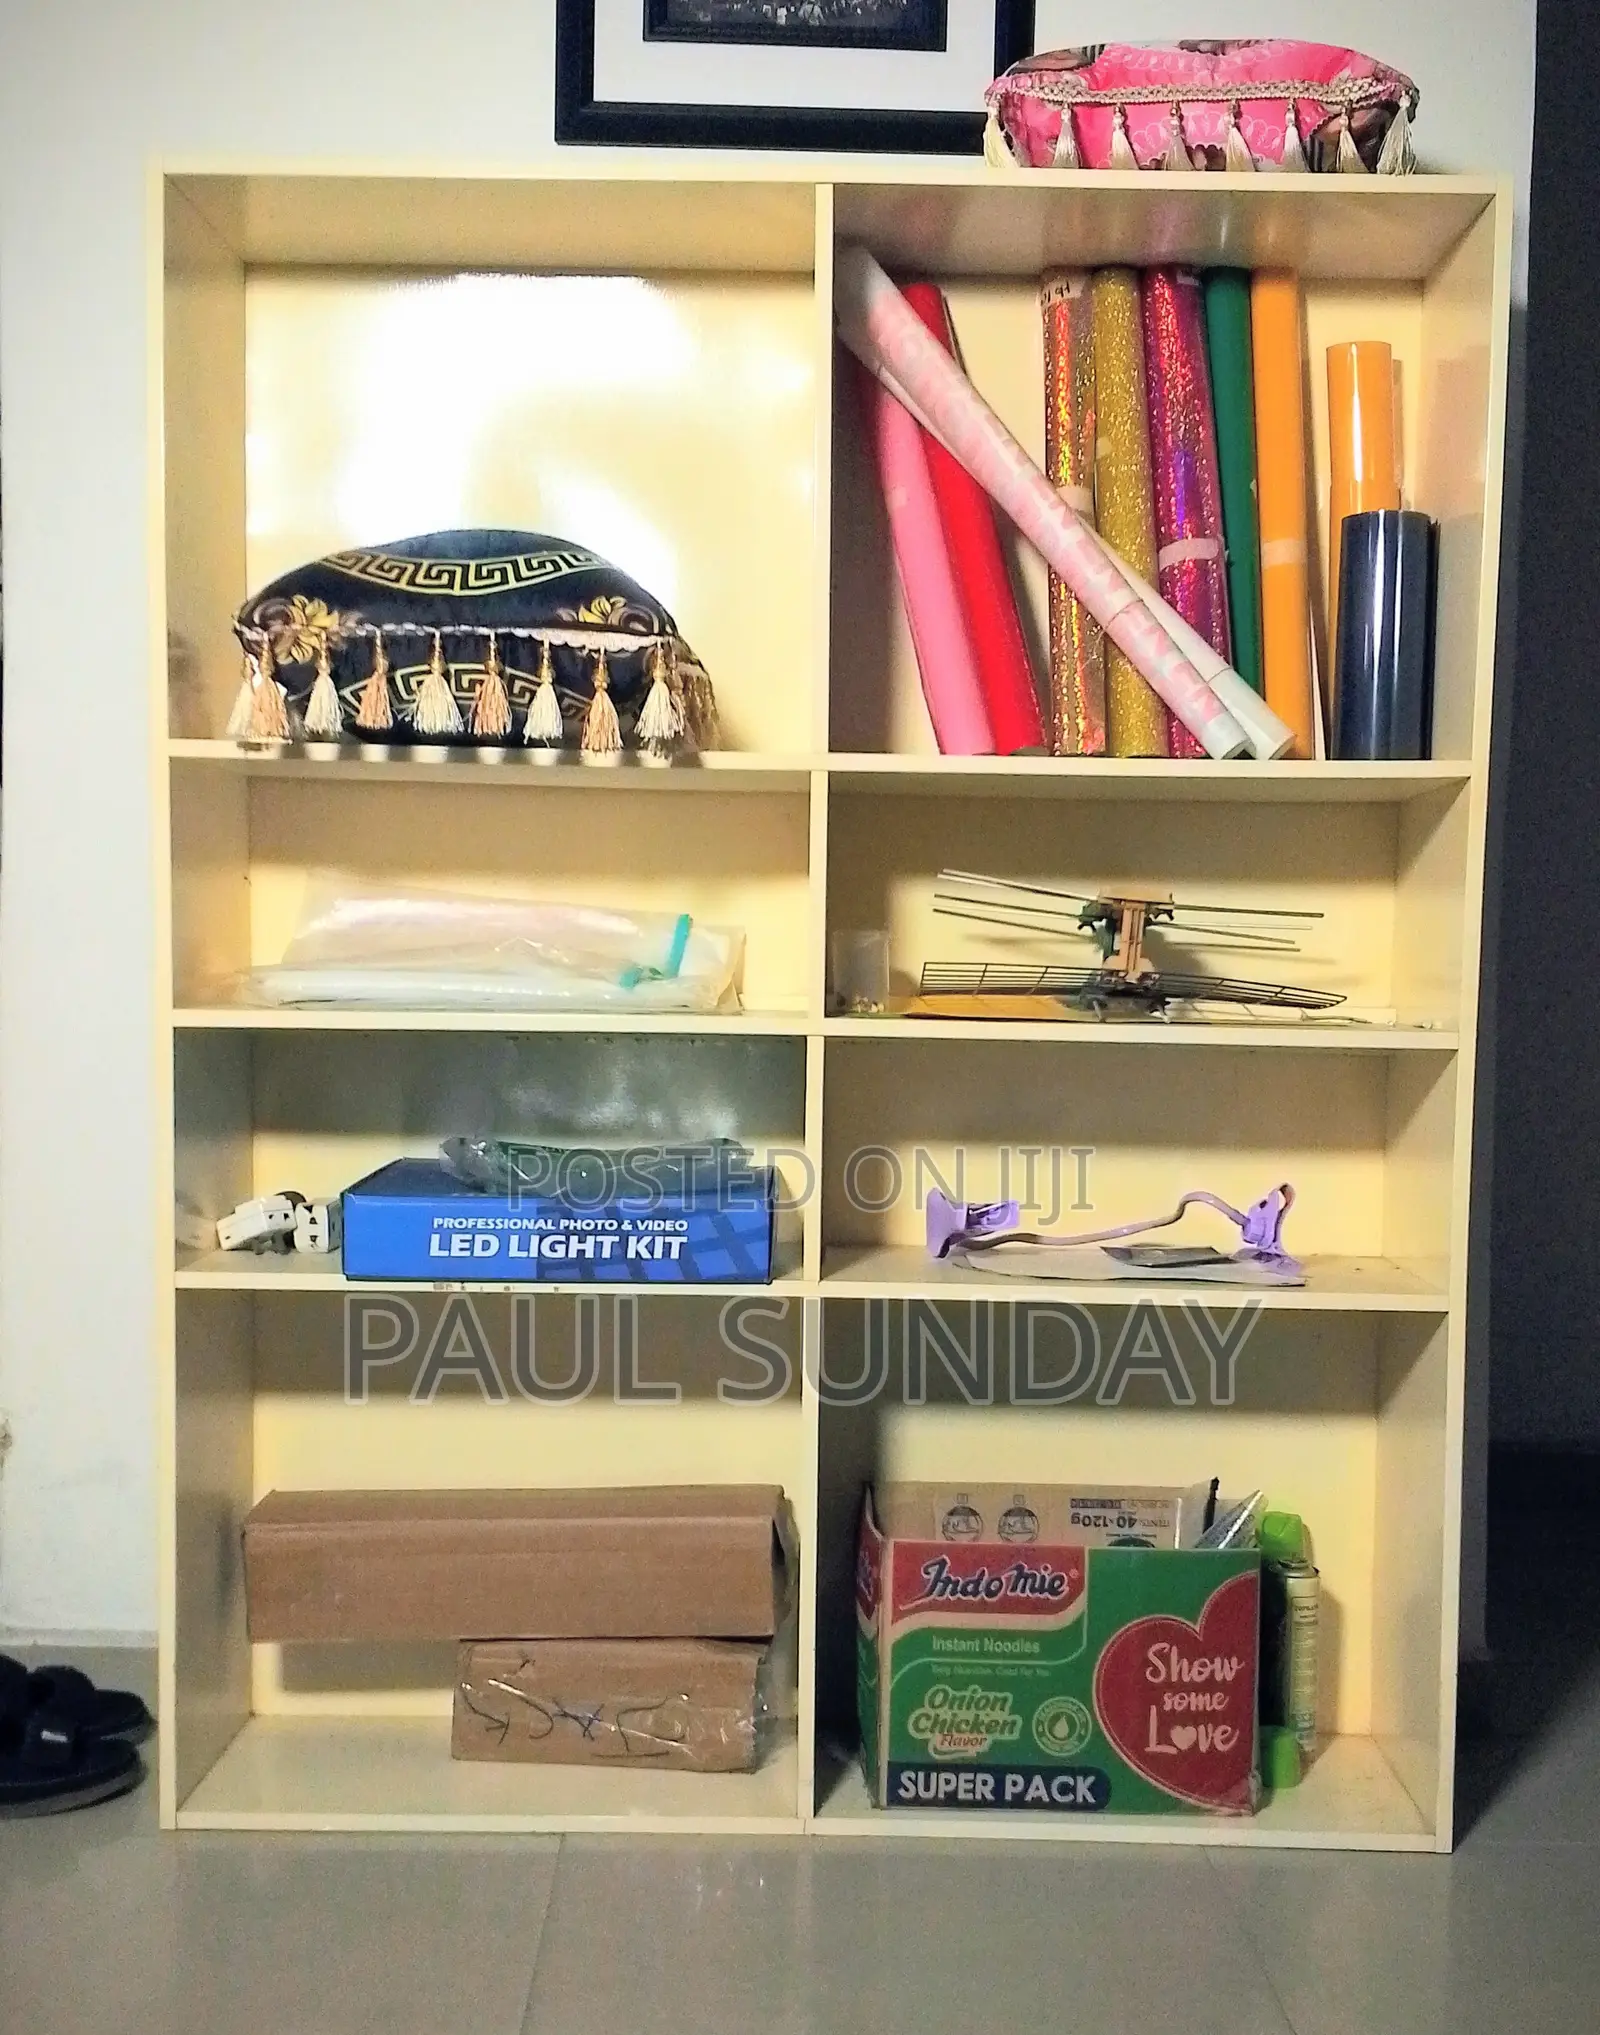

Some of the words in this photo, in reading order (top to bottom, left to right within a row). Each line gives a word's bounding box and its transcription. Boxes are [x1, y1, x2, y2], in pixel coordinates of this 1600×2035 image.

[433, 1217, 557, 1231] PROFESSIONAL
[559, 1218, 619, 1232] PHOTO
[621, 1219, 634, 1232] &
[636, 1219, 689, 1232] VIDEO
[429, 1233, 500, 1258] LED
[508, 1234, 620, 1260] LIGHT
[626, 1235, 688, 1261] KIT
[920, 1554, 1069, 1602] Indomie
[932, 1635, 980, 1652] Instant
[983, 1636, 1041, 1654] Noodles
[1145, 1641, 1246, 1684] Show
[925, 1685, 1011, 1713] Onion
[1162, 1690, 1230, 1712] some
[911, 1711, 1019, 1736] Chicken
[938, 1733, 989, 1748] Flavor
[897, 1770, 996, 1801] SUPER
[1004, 1773, 1097, 1805] PACK
